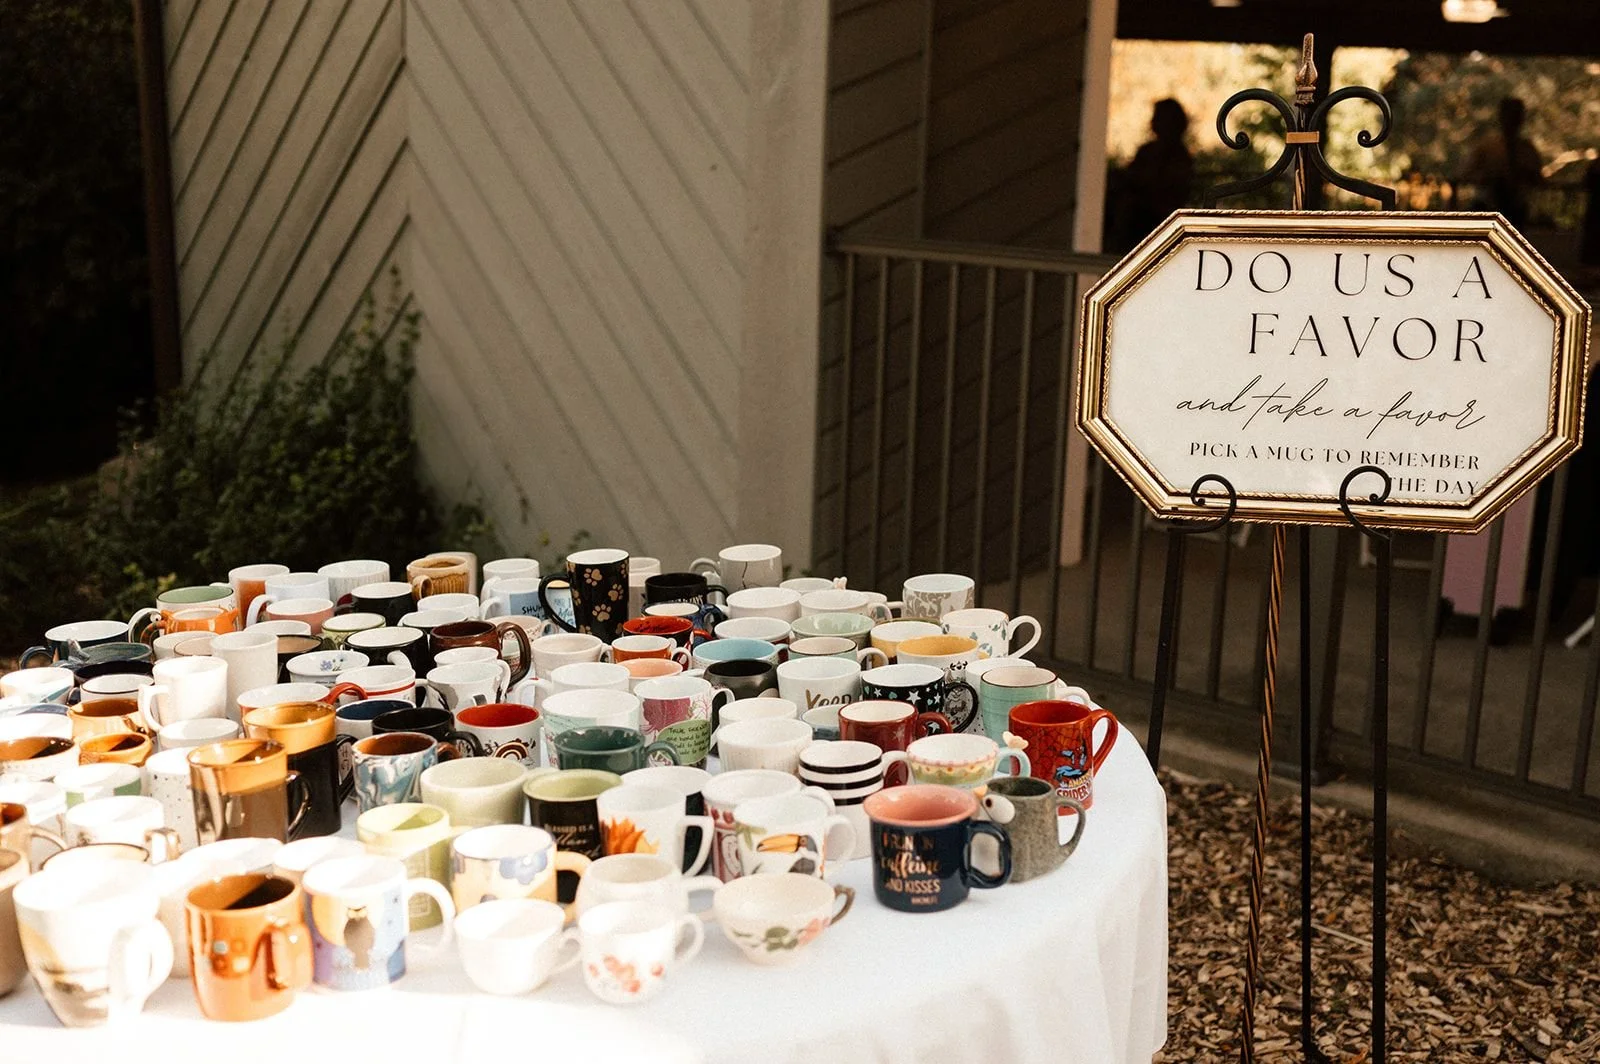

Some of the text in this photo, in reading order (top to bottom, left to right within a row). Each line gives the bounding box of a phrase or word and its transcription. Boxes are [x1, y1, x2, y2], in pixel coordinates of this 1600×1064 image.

[1195, 249, 1493, 300] DO US A
[1248, 312, 1488, 364] FAVOR
[1176, 374, 1487, 440] and take a favor
[1189, 441, 1480, 471] PICK A MUG TO REMEMBER
[1436, 479, 1480, 496] DAY
[904, 879, 941, 893] KISSES
